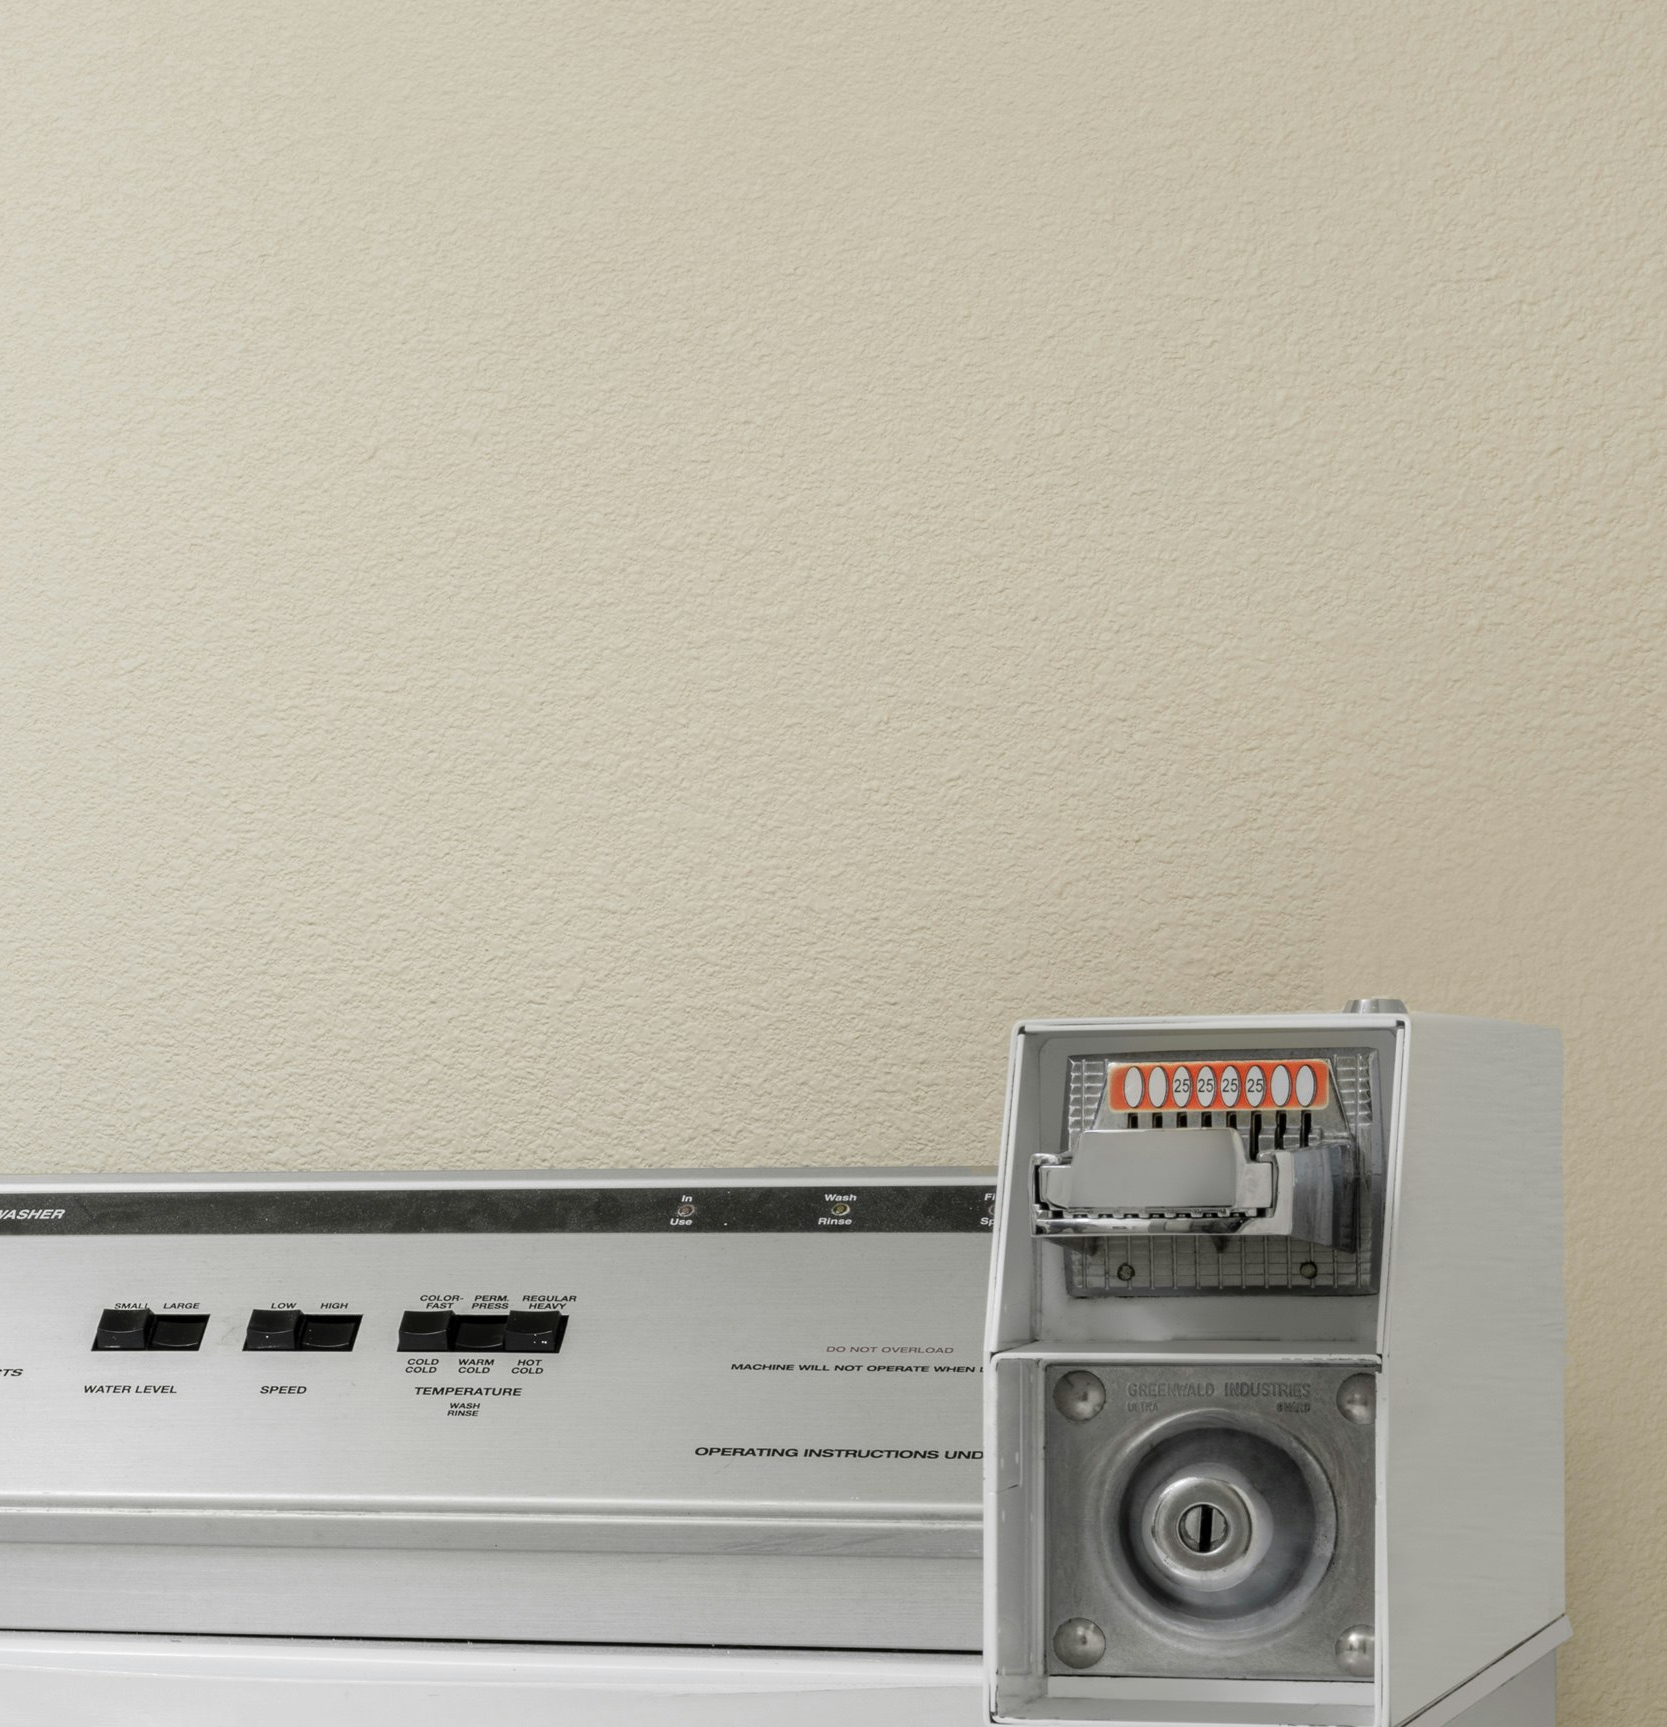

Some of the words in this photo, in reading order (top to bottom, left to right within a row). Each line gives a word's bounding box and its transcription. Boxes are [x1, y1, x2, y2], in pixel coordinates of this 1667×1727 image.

[1174, 1078, 1190, 1094] 25
[1197, 1078, 1214, 1094] 25
[1222, 1078, 1239, 1094] 25
[1247, 1078, 1264, 1094] 25
[670, 1218, 693, 1226] Use
[980, 1217, 995, 1227] Sp
[84, 1386, 131, 1394] WATER
[135, 1386, 177, 1394] LEVEL
[260, 1386, 307, 1394] SPEED
[415, 1387, 522, 1396] TEMPERATURE
[695, 1447, 799, 1458] OPERATING
[803, 1448, 939, 1460] INSTRUCTIONS
[944, 1450, 984, 1460] UND
